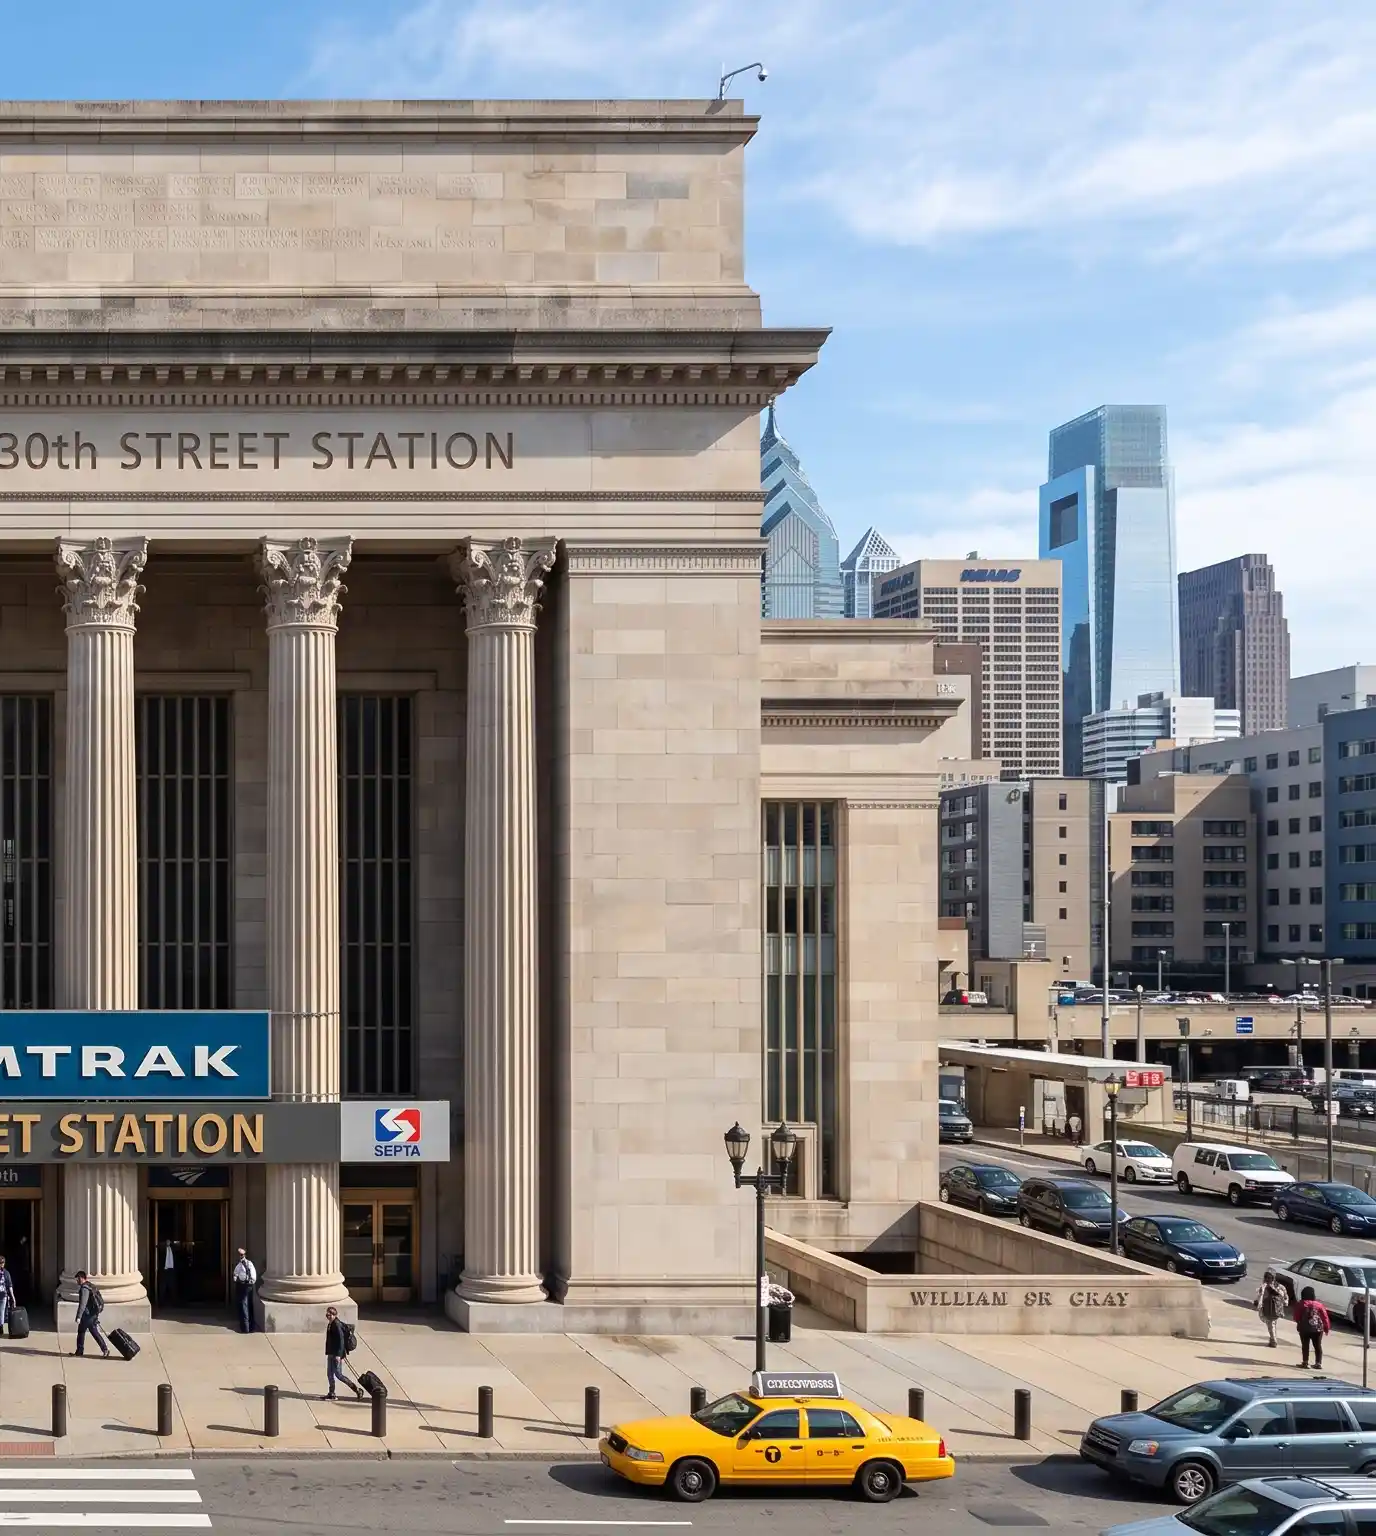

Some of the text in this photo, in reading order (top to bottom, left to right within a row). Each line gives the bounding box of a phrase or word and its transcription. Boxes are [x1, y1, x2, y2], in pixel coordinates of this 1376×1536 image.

[119, 432, 290, 470] STREET
[312, 432, 514, 470] STATION
[59, 1113, 265, 1154] STATION
[374, 1145, 421, 1158] SEPTA
[909, 1291, 1008, 1306] WILLIAM
